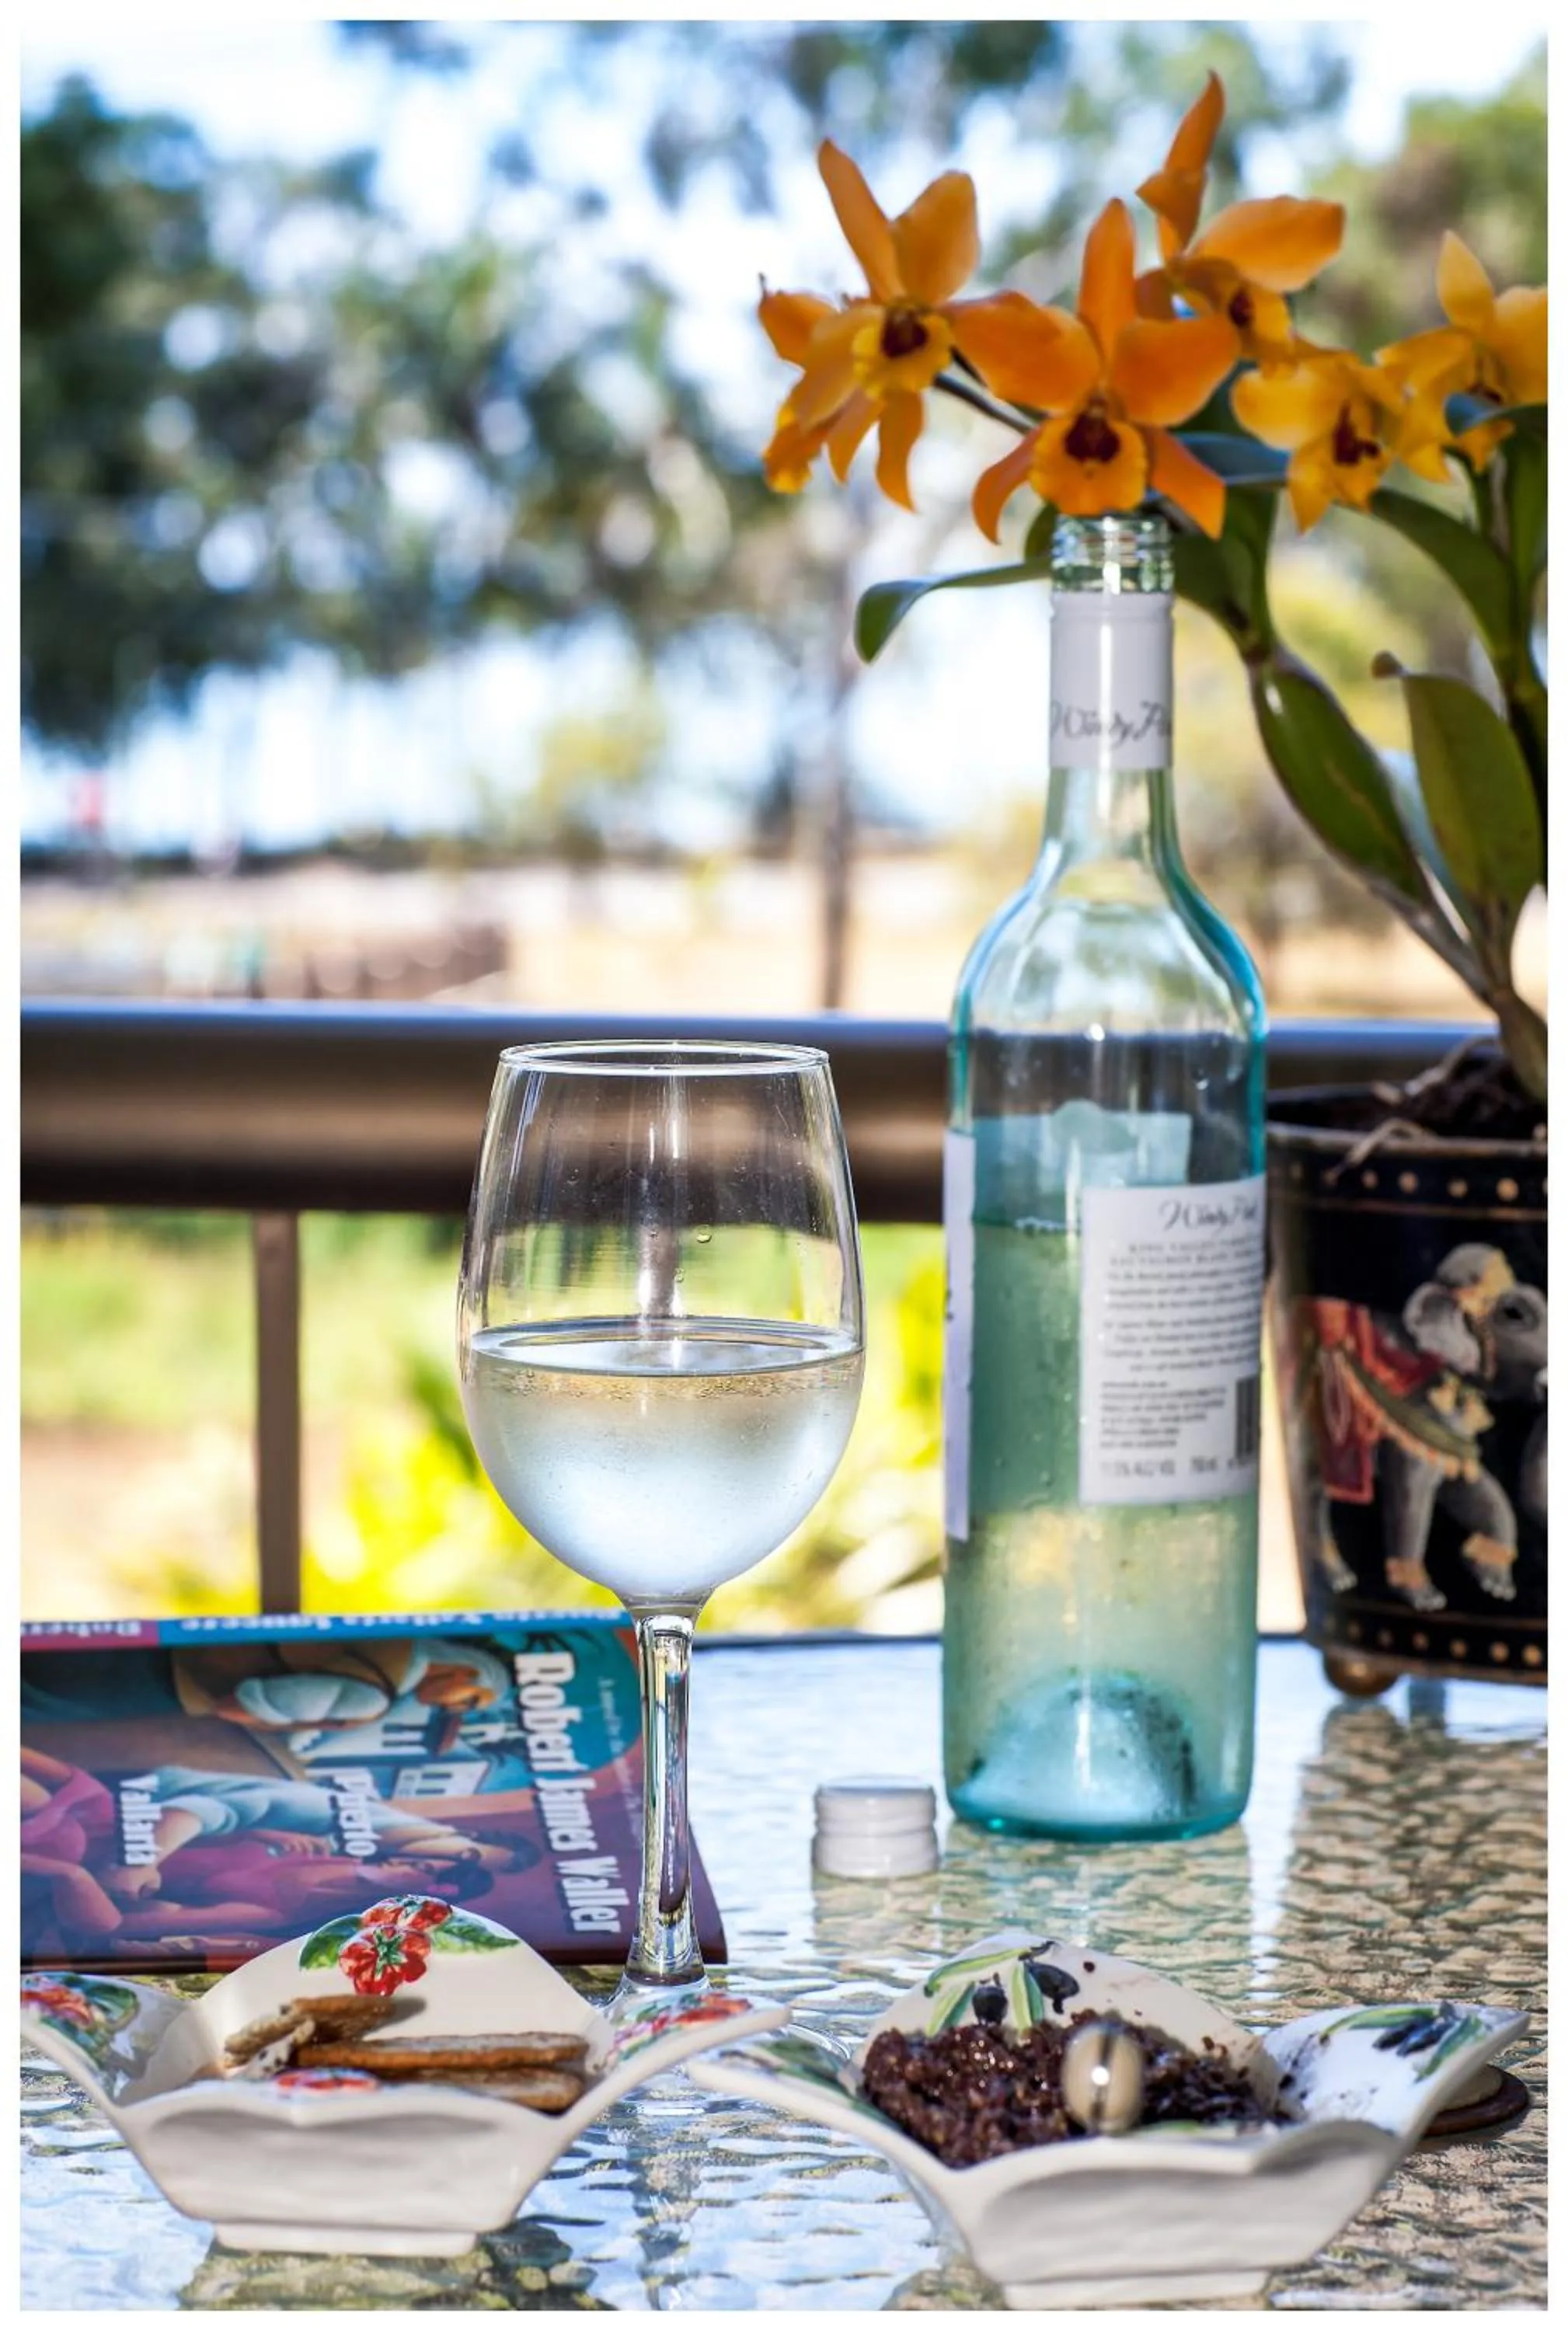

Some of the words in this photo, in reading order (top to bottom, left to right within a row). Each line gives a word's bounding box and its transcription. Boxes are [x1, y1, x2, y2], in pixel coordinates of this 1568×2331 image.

[514, 1651, 591, 1772] Robert
[119, 1774, 162, 1866] Vallarta
[333, 1766, 382, 1857] Puerto
[534, 1777, 598, 1852] James
[556, 1855, 630, 1933] Waller
